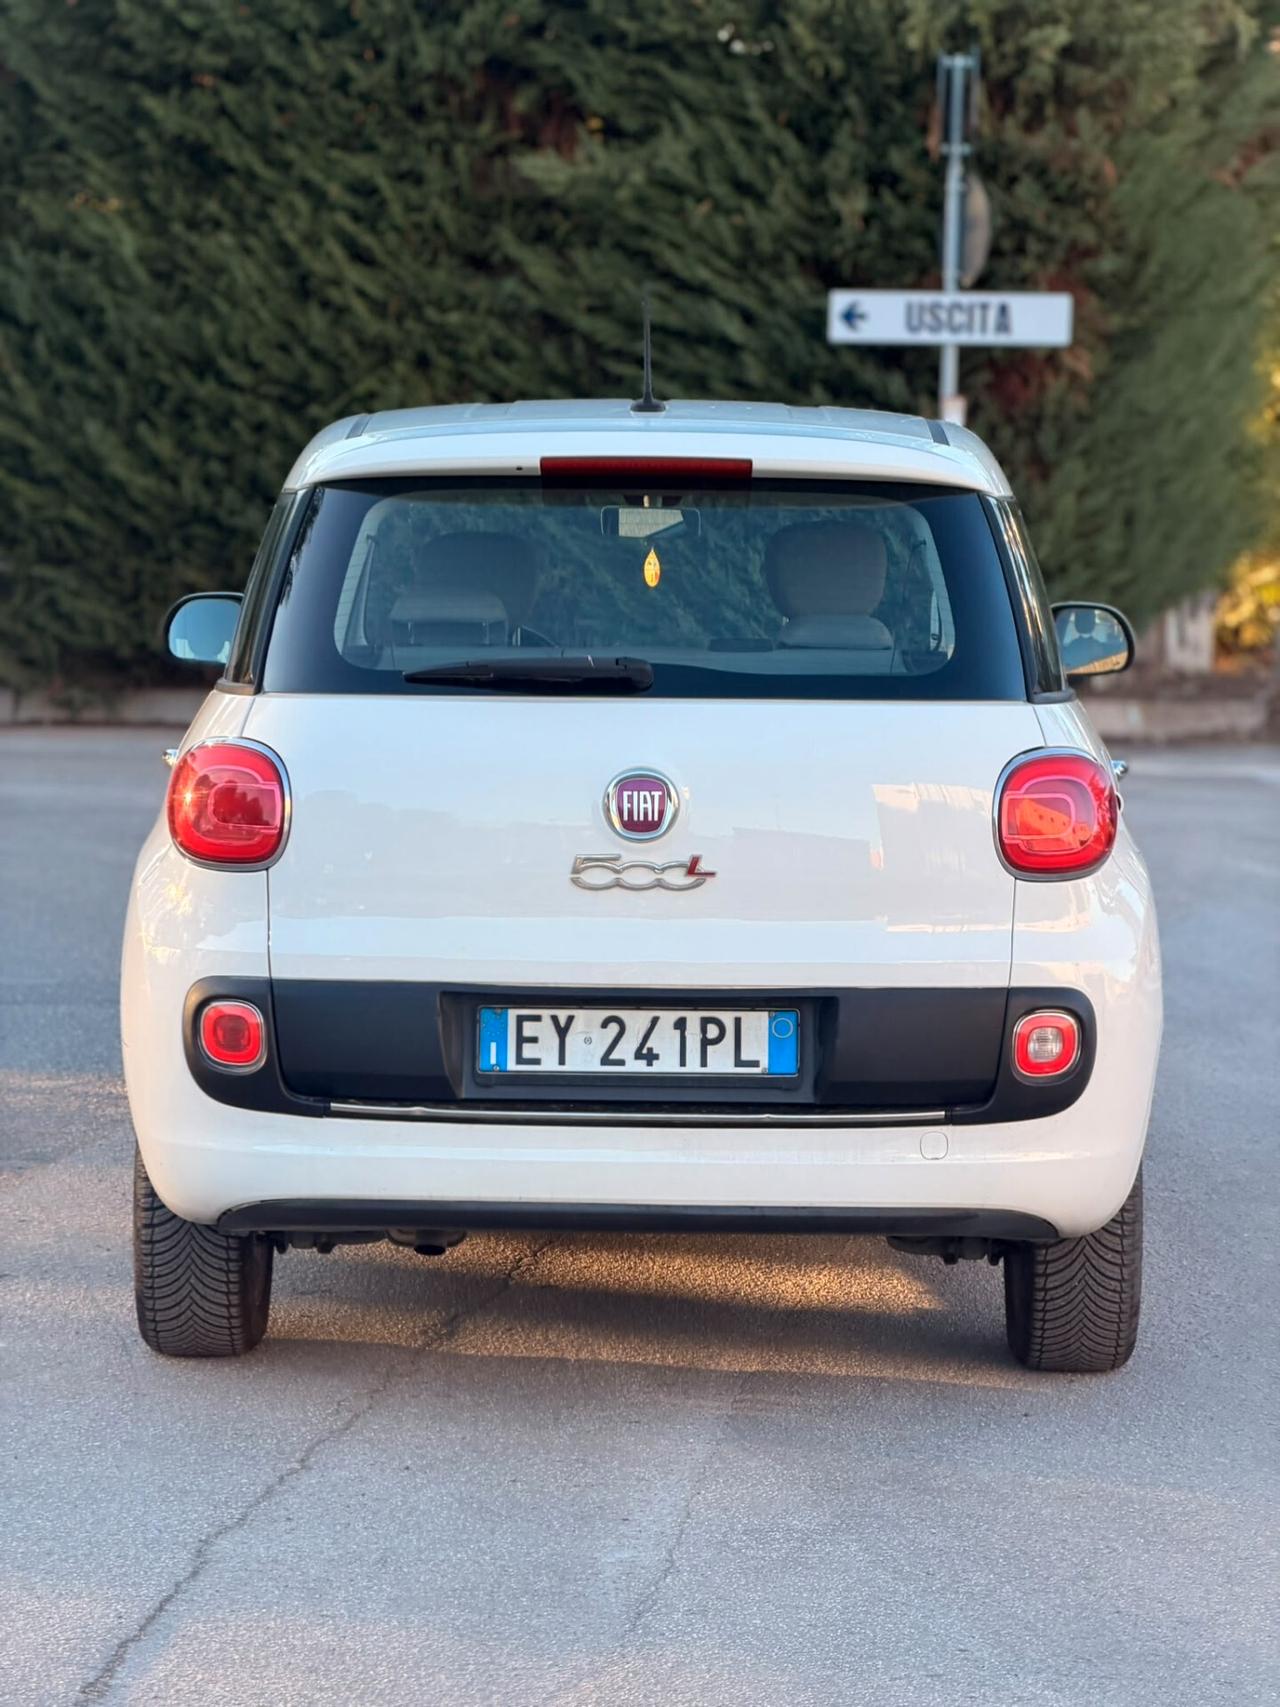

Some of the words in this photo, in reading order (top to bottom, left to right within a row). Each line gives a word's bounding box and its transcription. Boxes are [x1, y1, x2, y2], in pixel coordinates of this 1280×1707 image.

[905, 301, 1012, 335] USCITA
[622, 790, 663, 822] FIAT
[571, 853, 717, 891] 500L
[490, 1041, 497, 1065] I
